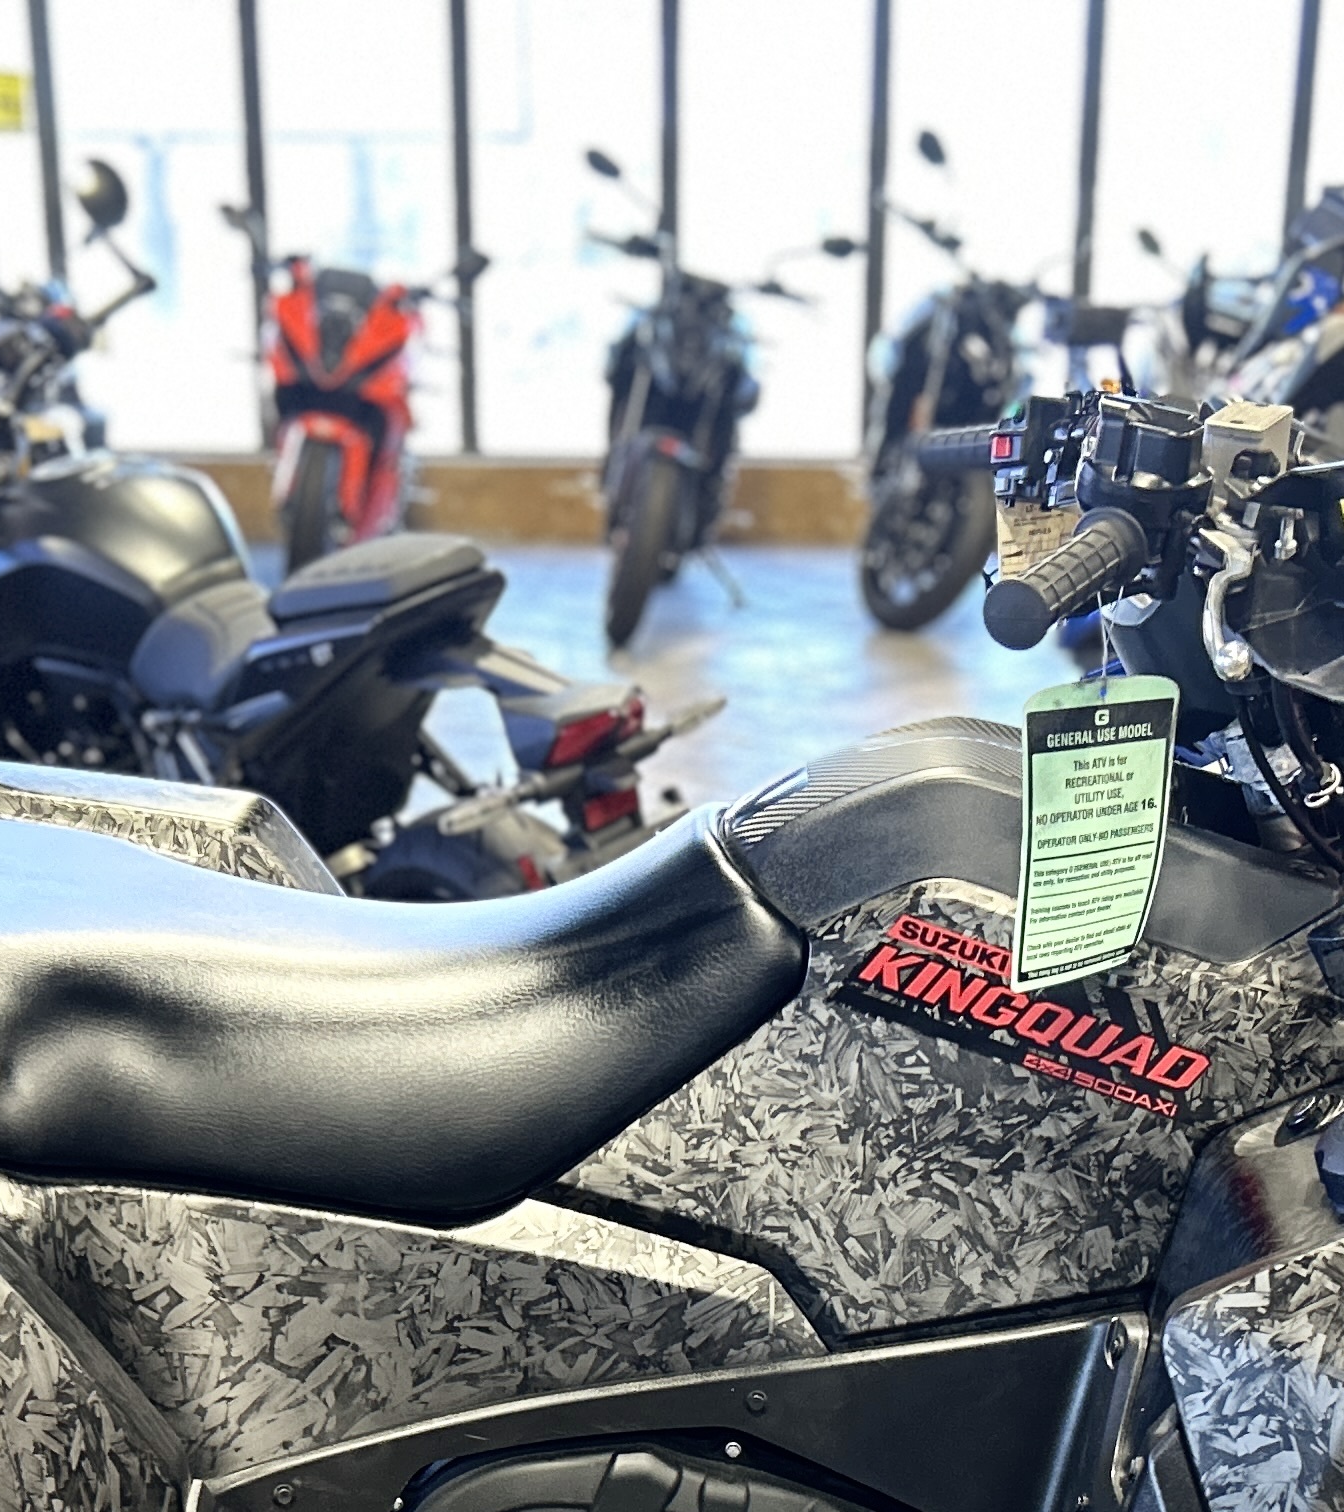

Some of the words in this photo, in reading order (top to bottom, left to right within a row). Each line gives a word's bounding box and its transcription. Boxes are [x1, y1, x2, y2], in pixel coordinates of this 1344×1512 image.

[1046, 730, 1095, 748] GENERAL
[1097, 726, 1117, 743] USE
[1118, 722, 1153, 740] MODEL
[1073, 760, 1090, 772] This
[1092, 757, 1107, 769] ATV
[1109, 756, 1115, 766] is
[1117, 754, 1128, 766] for
[1065, 771, 1125, 789] RECREATIONAL
[1126, 772, 1135, 781] or
[1074, 789, 1105, 804] UTILITY
[1036, 814, 1047, 826] NO
[1050, 808, 1094, 824] OPERATOR
[1096, 804, 1122, 818] UNDER
[1124, 801, 1138, 813] AGE
[1037, 835, 1077, 849] OPERATOR
[1110, 822, 1154, 839] PASSENGERS
[899, 919, 1011, 972] SUZUKI
[859, 943, 1210, 1089] KINGQUAD
